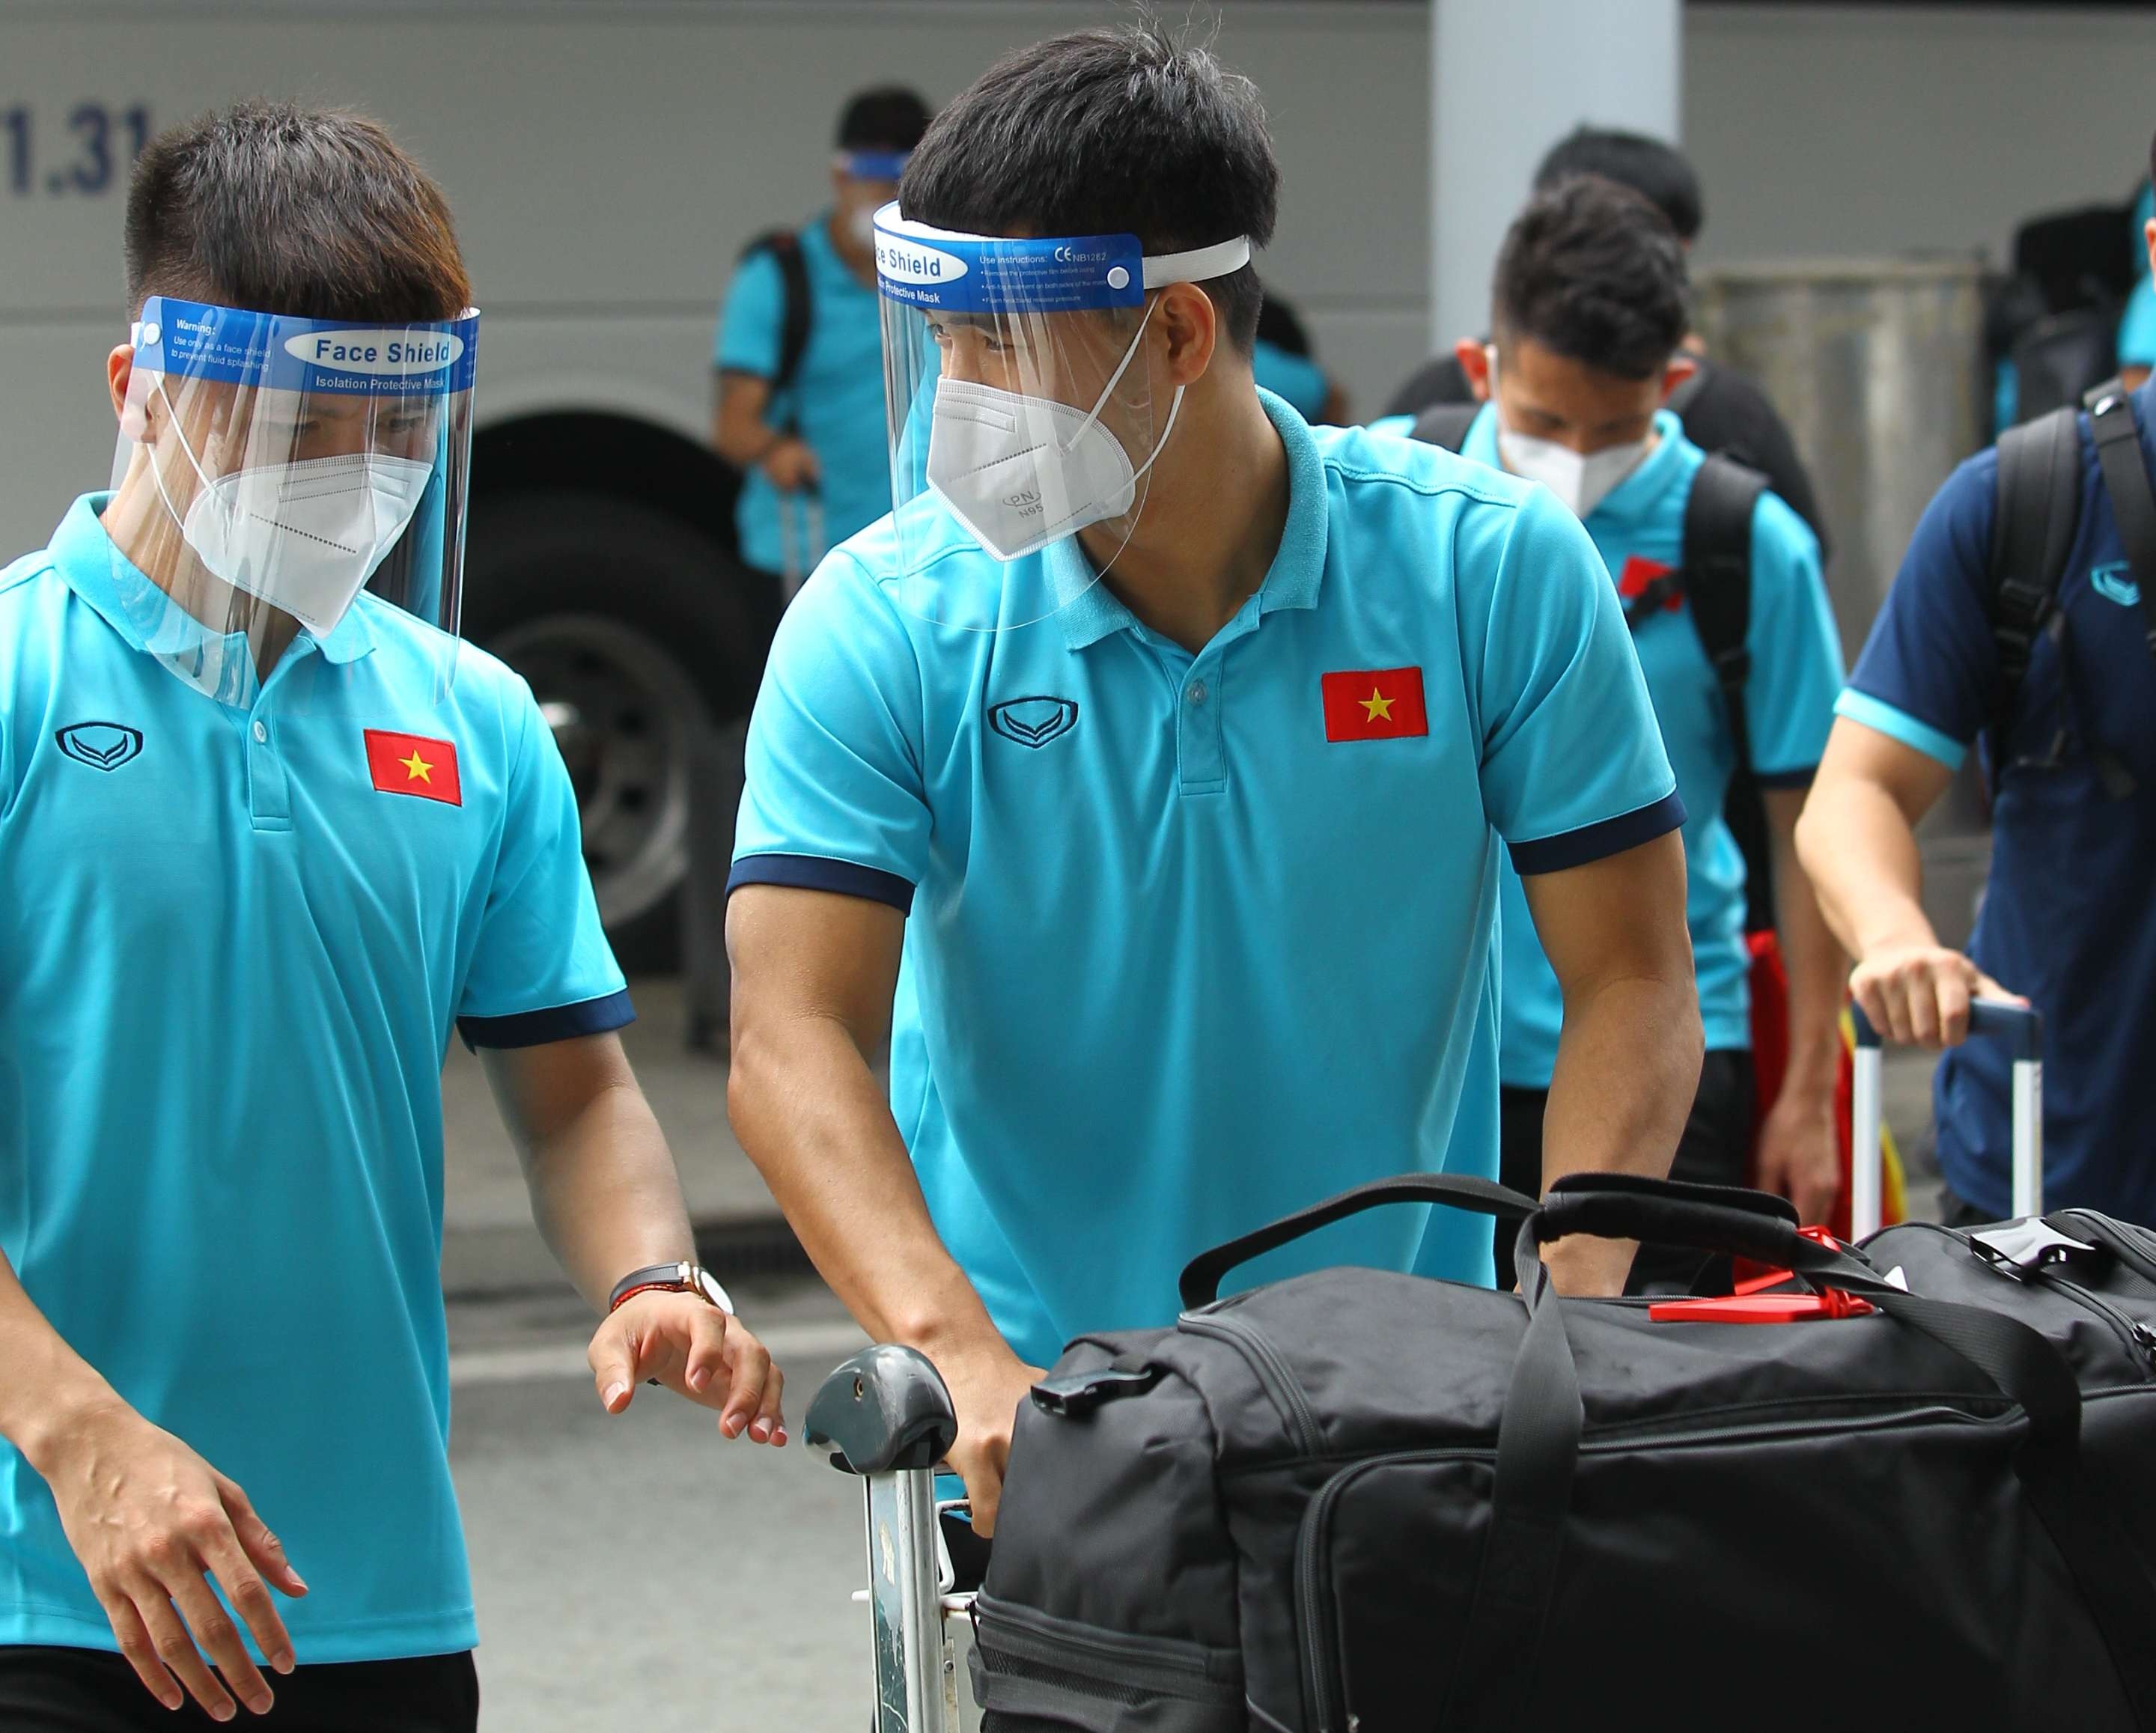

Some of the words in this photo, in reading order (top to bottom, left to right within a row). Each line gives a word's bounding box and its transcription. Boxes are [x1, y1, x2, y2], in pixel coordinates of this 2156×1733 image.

[889, 248, 941, 277] Shield
[979, 255, 996, 264] Use
[997, 255, 1047, 264] instructions:
[1054, 246, 1071, 263] CE
[885, 281, 915, 300] Protective
[916, 290, 941, 304] Mask
[176, 318, 216, 336] Warning:
[174, 335, 186, 346] Use
[187, 341, 202, 350] only
[224, 344, 242, 354] face
[245, 347, 271, 358] shield
[316, 339, 377, 362] Face
[387, 341, 450, 364] Shield
[171, 348, 178, 357] to
[179, 350, 207, 362] prevent
[208, 353, 225, 365] fluid
[227, 357, 270, 373] splashing
[316, 375, 367, 389] Isolation
[370, 377, 422, 390] Protective
[424, 379, 445, 389] Mask
[1019, 503, 1044, 518] N95
